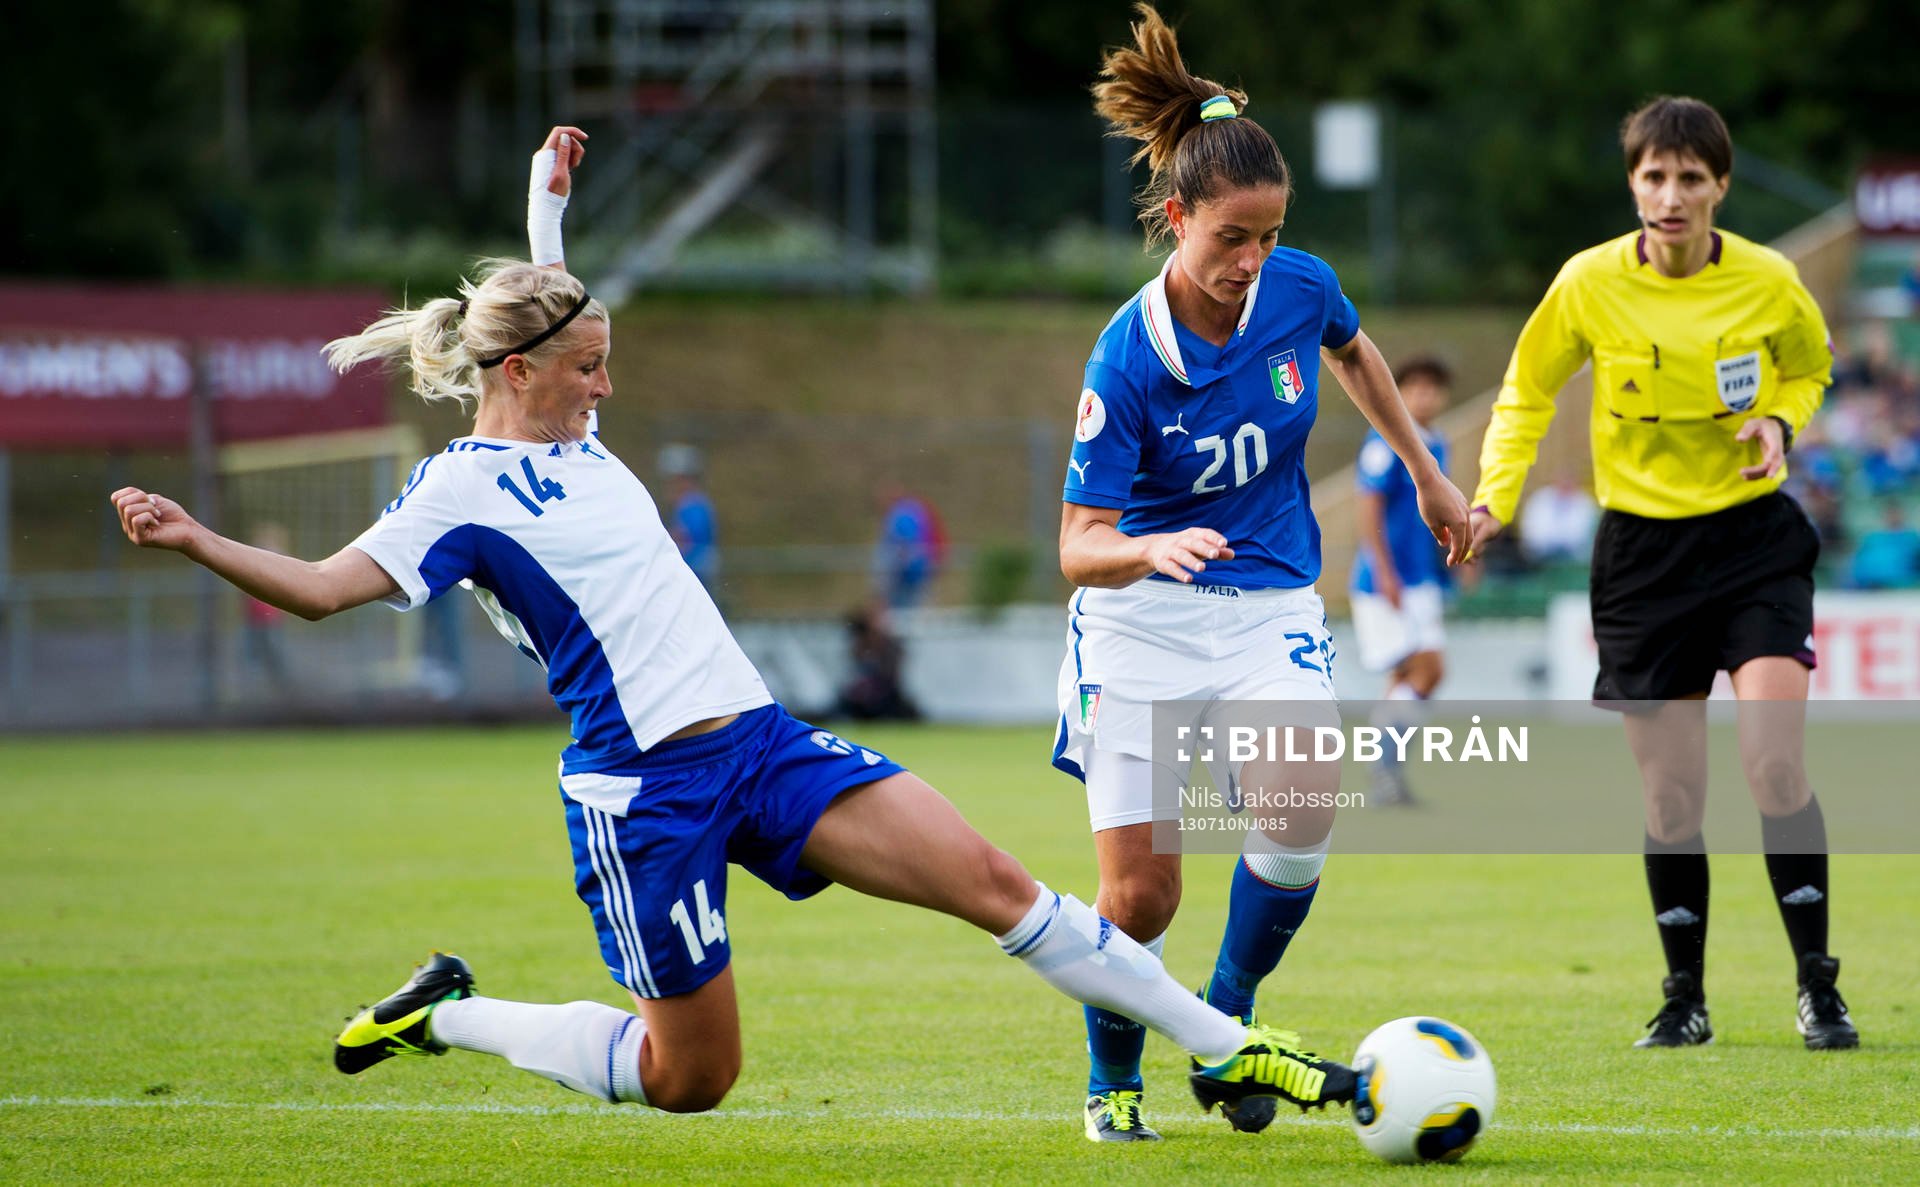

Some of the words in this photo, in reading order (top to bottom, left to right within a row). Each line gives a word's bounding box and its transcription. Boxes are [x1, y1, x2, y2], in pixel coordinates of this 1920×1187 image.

[1271, 354, 1292, 366] ITALIA
[1724, 375, 1755, 393] FIFA
[1192, 422, 1268, 494] 20
[496, 455, 567, 518] 14
[1195, 584, 1239, 598] ITALIA
[669, 879, 727, 965] 14
[1229, 1053, 1327, 1101] PUMA
